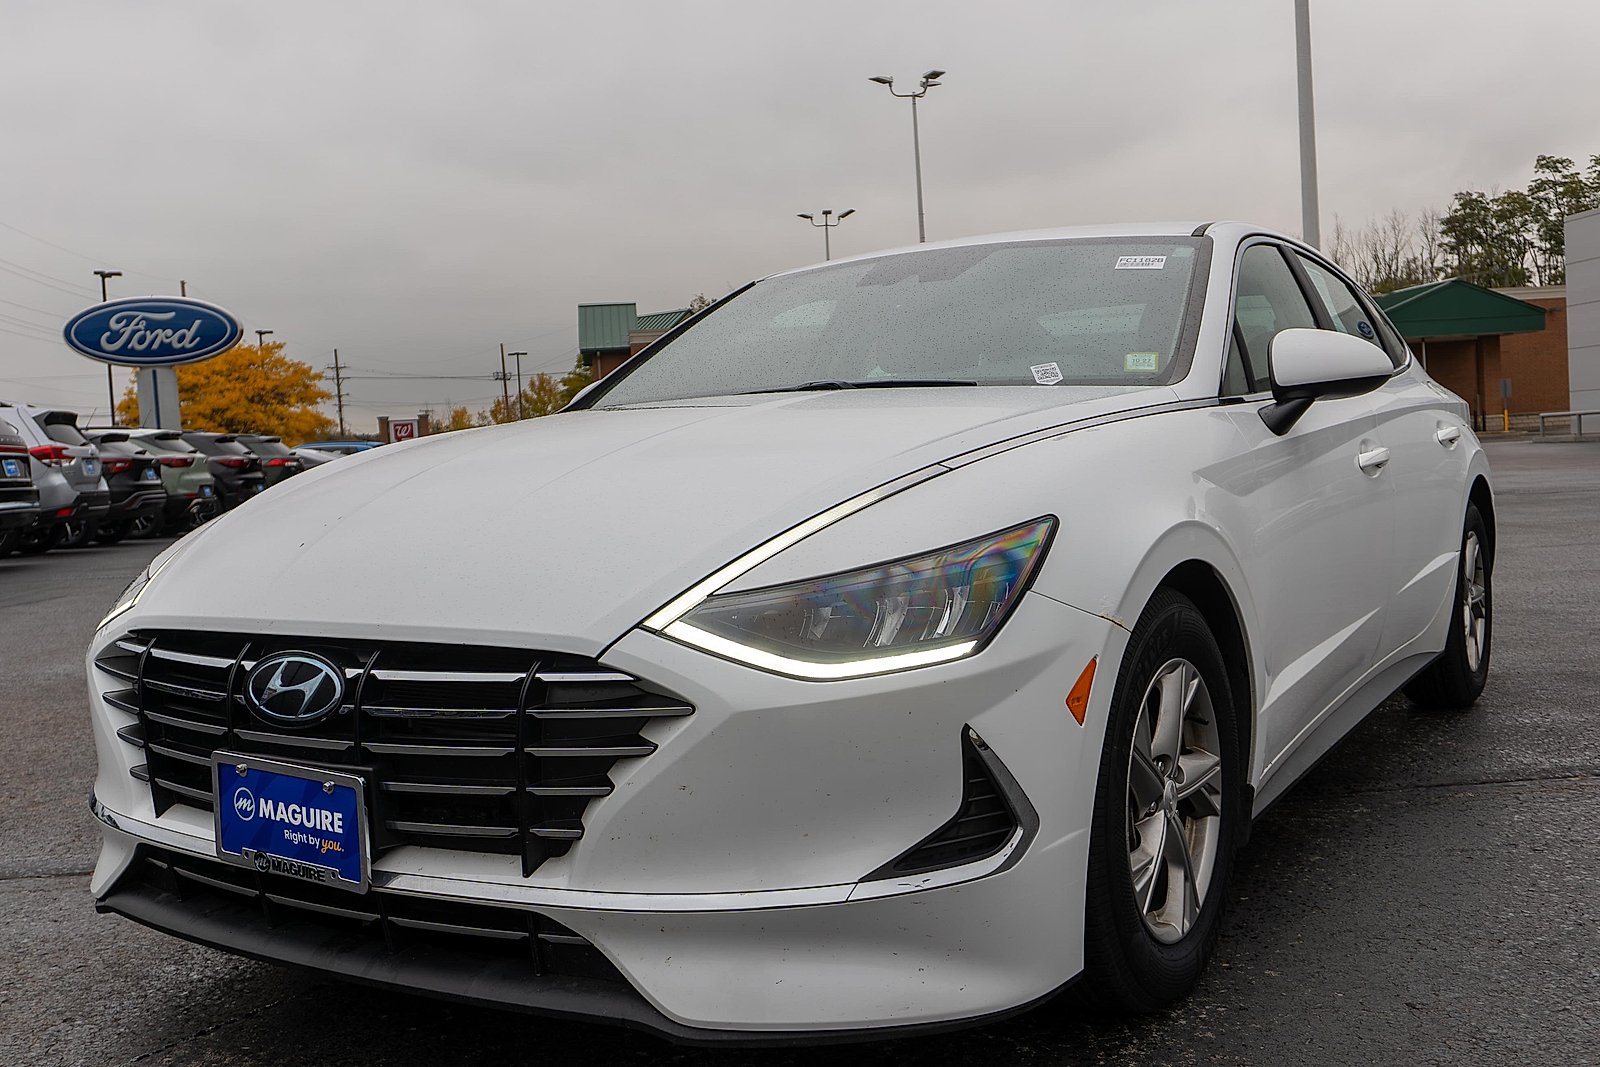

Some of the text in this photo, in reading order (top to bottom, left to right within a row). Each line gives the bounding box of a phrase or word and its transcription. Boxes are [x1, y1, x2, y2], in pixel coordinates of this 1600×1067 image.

[100, 311, 202, 352] Ford
[259, 798, 343, 834] MAGUIRE
[284, 830, 345, 853] Right by you.
[271, 858, 326, 882] MAGUIRE
